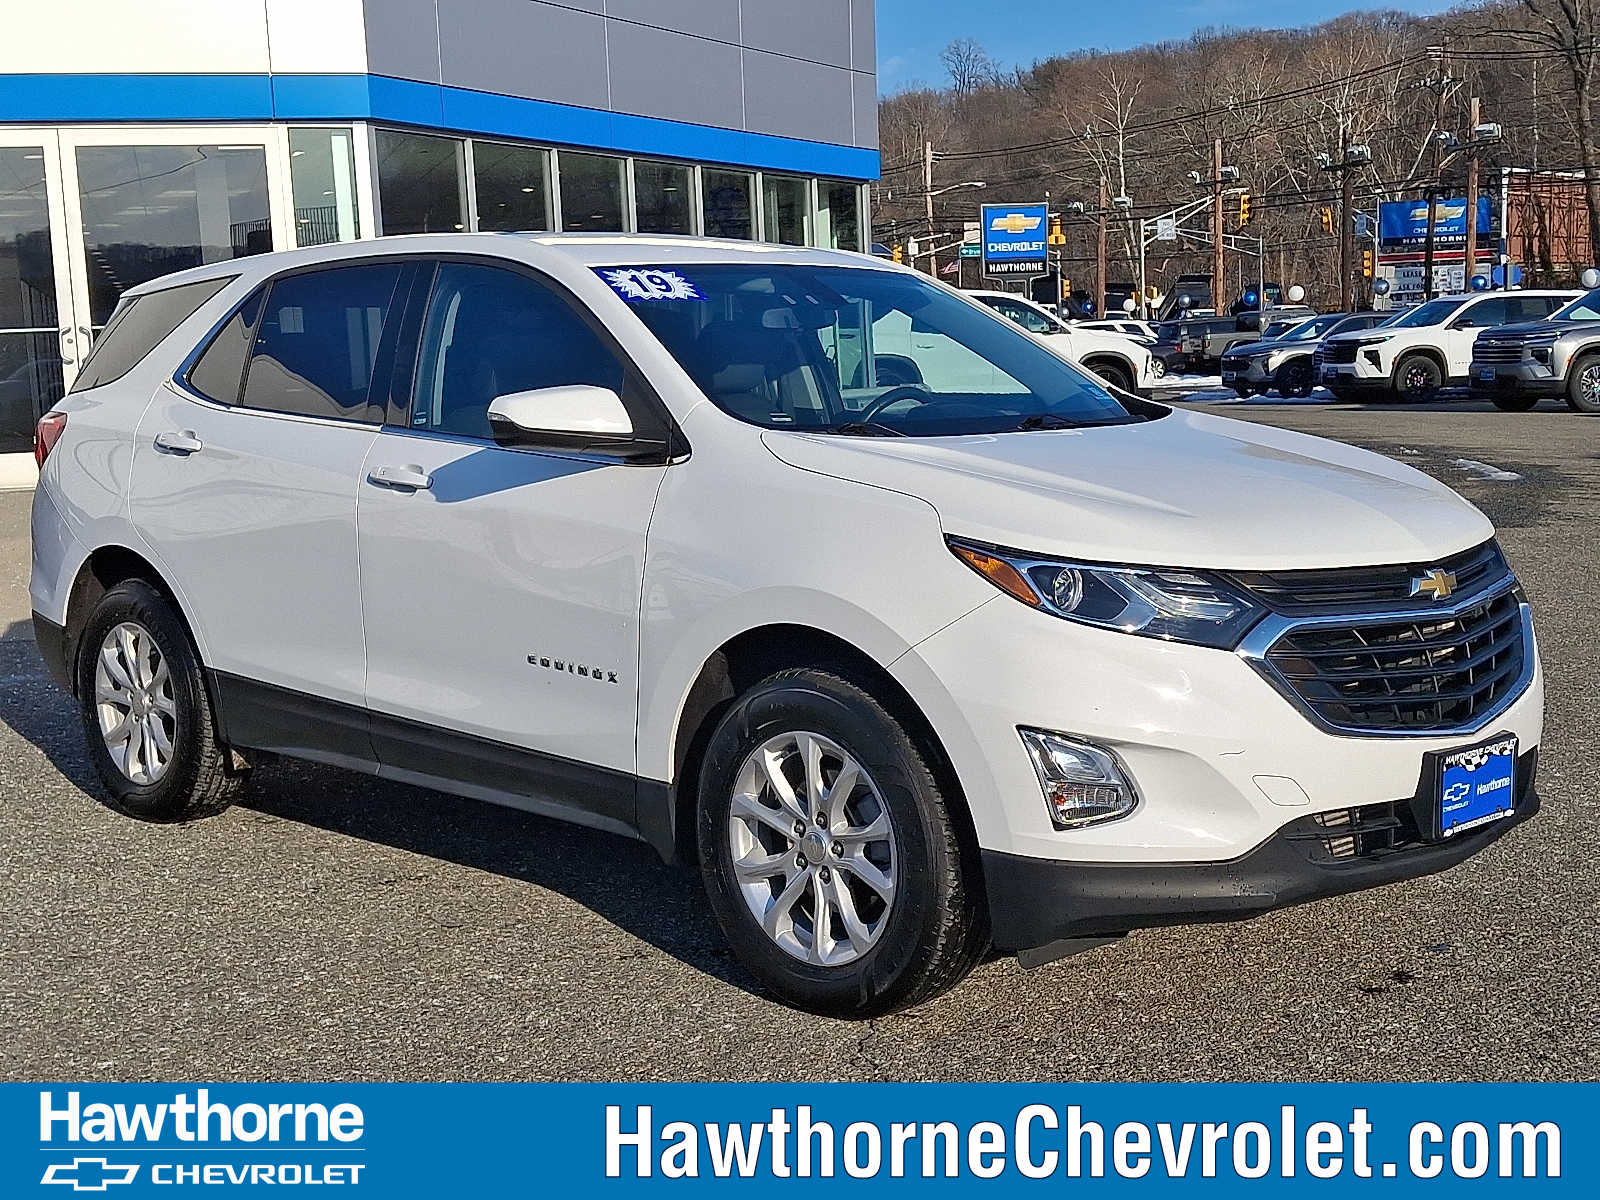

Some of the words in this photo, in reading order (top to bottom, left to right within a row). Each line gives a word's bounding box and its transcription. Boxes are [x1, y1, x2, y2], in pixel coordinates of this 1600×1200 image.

[1402, 235, 1466, 244] HAWHORN
[988, 242, 1045, 252] CHEVROLET
[989, 262, 1043, 272] HAWTHORNE
[628, 274, 673, 293] 19
[527, 653, 618, 683] EQUINOX
[1477, 776, 1511, 795] Hawthorne
